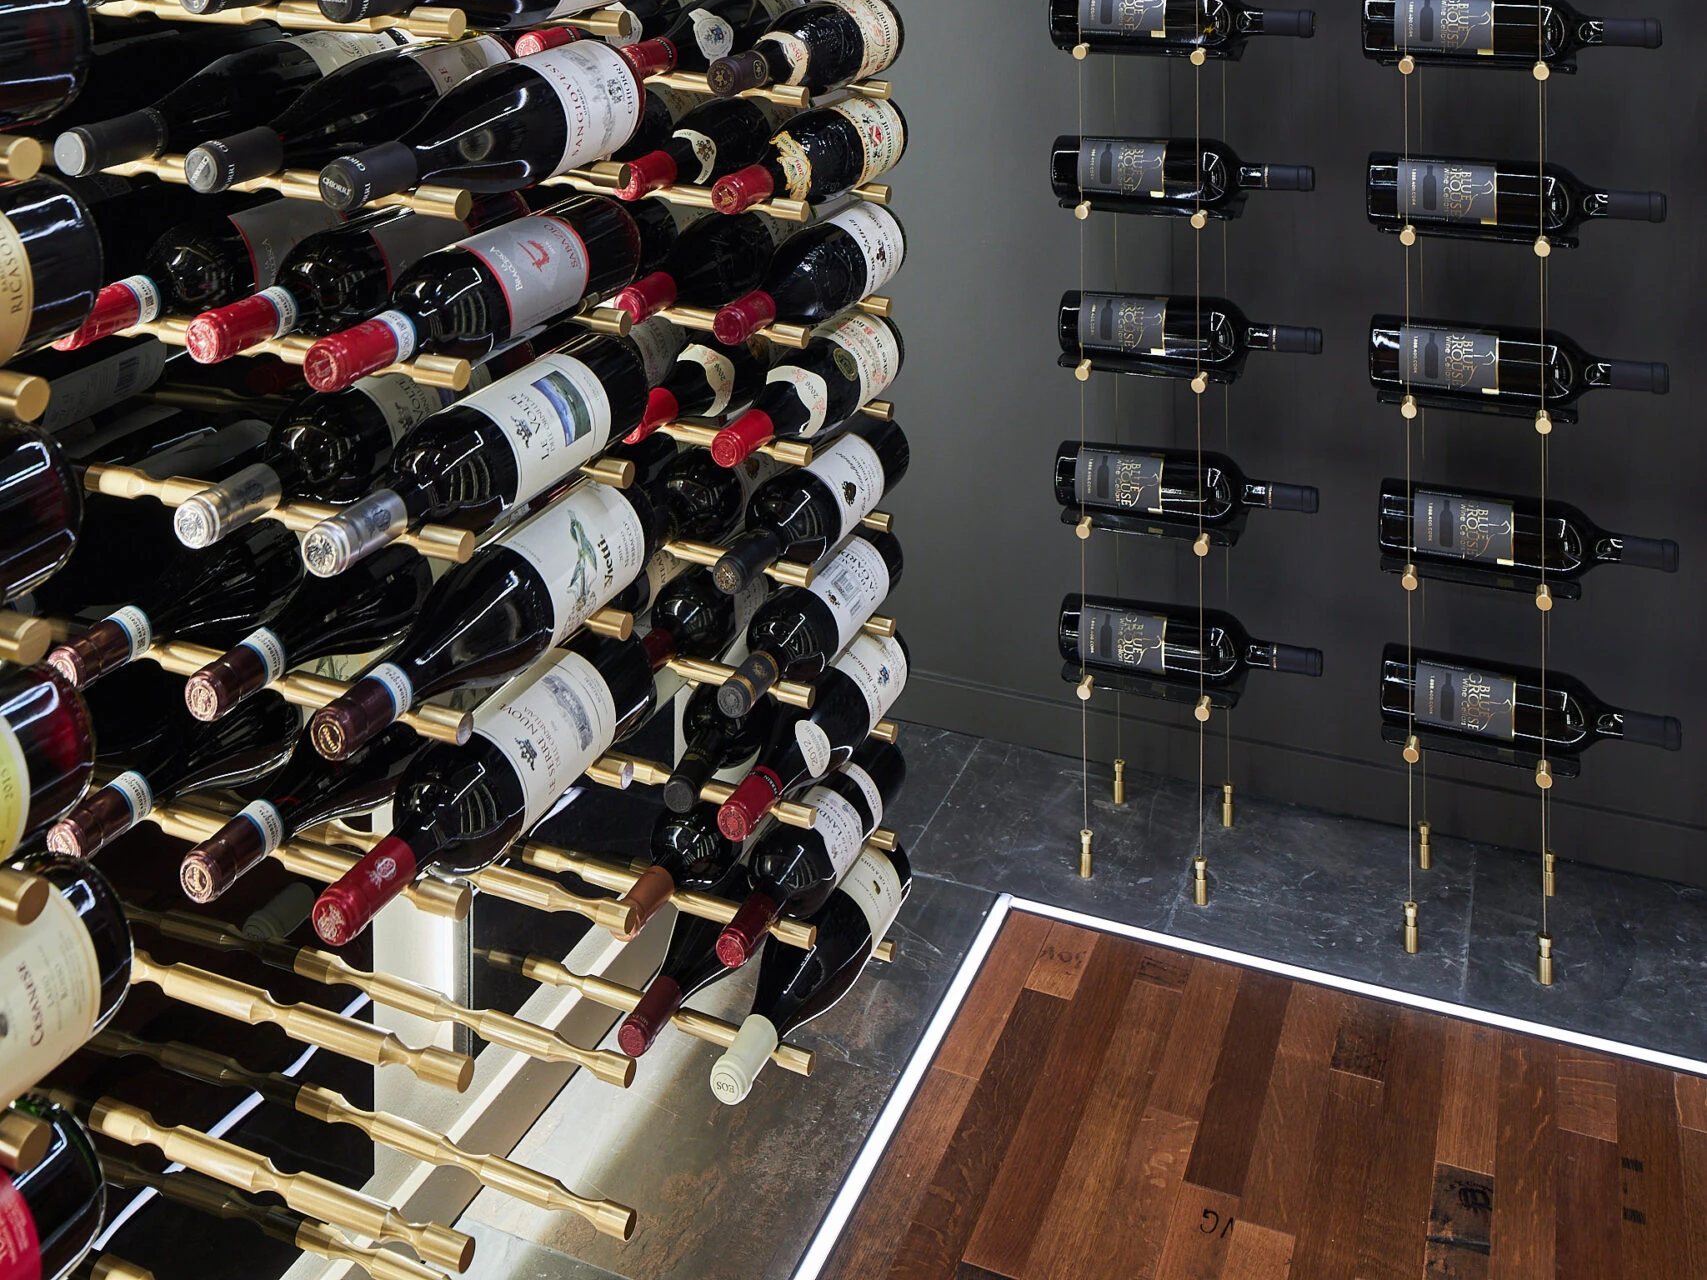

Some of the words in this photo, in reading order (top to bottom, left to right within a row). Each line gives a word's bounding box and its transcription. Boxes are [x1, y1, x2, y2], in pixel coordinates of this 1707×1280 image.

[1459, 3, 1469, 31] BLUE
[614, 62, 634, 115] CHIORRI
[541, 61, 583, 157] SANGIOVESE
[1133, 149, 1144, 174] BLUE
[322, 176, 352, 195] CHIORRI
[1461, 171, 1472, 200] BLUE
[543, 222, 579, 268] SABAZIO
[489, 246, 524, 292] BRACCESCA
[873, 335, 883, 349] du
[1462, 341, 1474, 370] BLUE
[712, 363, 727, 382] 2006
[804, 380, 819, 400] 2006
[508, 393, 542, 433] VOLTE
[540, 439, 550, 461] LE
[1120, 460, 1131, 505] ROUSE
[1130, 463, 1141, 492] BLUE
[1478, 509, 1489, 538] BLUE
[623, 522, 637, 566] PERBACCO
[1133, 624, 1144, 653] BLUE
[1468, 672, 1482, 730] GROUSE
[1479, 684, 1490, 716] BLUE
[497, 703, 539, 735] NUOVE
[535, 735, 557, 776] SERRE
[802, 739, 820, 767] 2012
[860, 857, 887, 885] GRANDIS
[14, 961, 46, 1047] CESANESE
[716, 1081, 735, 1093] EOS
